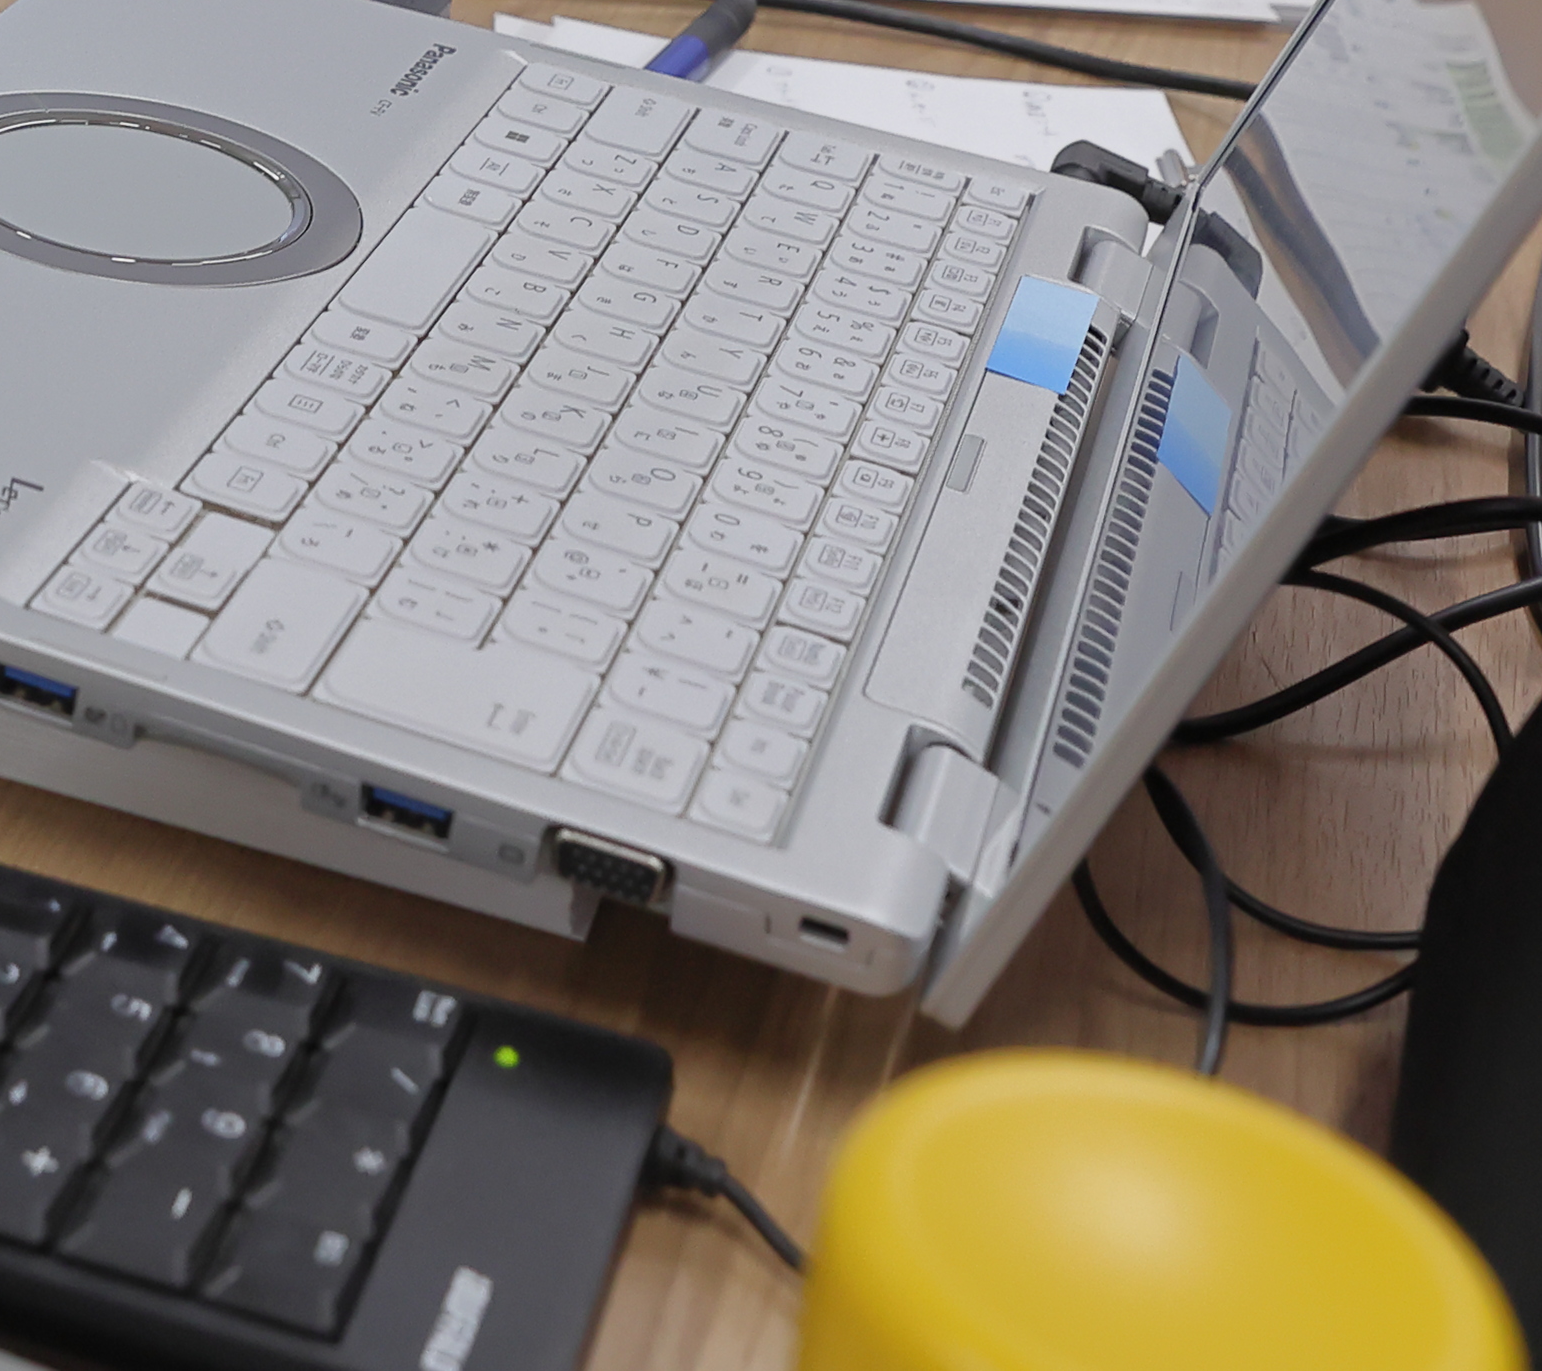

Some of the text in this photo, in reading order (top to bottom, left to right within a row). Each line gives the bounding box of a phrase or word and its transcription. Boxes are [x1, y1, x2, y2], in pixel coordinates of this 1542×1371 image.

[390, 43, 456, 96] Panasonic
[614, 154, 637, 165] Z
[486, 161, 501, 171] Alt
[714, 162, 737, 173] A
[592, 183, 616, 196] X
[810, 180, 835, 190] Q
[884, 183, 905, 191] 1
[696, 194, 719, 204] S
[915, 190, 936, 198] !
[760, 216, 777, 224] て
[794, 211, 818, 225] W
[867, 210, 890, 221] 2
[570, 216, 593, 227] C
[677, 224, 700, 236] D
[776, 242, 800, 253] E
[851, 242, 874, 253] 3
[975, 246, 991, 255] F2
[548, 250, 571, 261] V
[886, 252, 905, 261] #
[657, 258, 679, 269] F
[758, 275, 783, 286] R
[835, 276, 857, 287] 4
[963, 273, 979, 283] F3
[484, 287, 501, 296] こ
[523, 282, 547, 293] B
[868, 285, 891, 295] $
[633, 292, 657, 303] G
[952, 304, 967, 313] F4
[739, 312, 763, 322] T
[817, 310, 841, 322] 5
[496, 317, 522, 331] N
[812, 324, 830, 333] え
[850, 320, 874, 332] %
[571, 334, 587, 342] く
[609, 326, 635, 340] H
[936, 337, 953, 347] F5
[718, 347, 744, 359] Y
[798, 347, 822, 359] 6
[468, 355, 496, 371] M
[833, 357, 856, 368] &
[586, 365, 610, 377] J
[696, 385, 723, 398] U
[779, 385, 804, 398] 7
[446, 399, 460, 408] <
[910, 403, 925, 414] F7
[560, 405, 586, 419] K
[674, 426, 699, 436] I
[758, 425, 784, 438] 8
[266, 433, 286, 448] Ctrl
[419, 439, 433, 449] >
[792, 438, 819, 448] (
[533, 448, 559, 458] L
[349, 472, 369, 486] /
[650, 467, 676, 482] O
[737, 467, 763, 480] 9
[773, 479, 799, 490] )
[382, 485, 406, 496] ?
[512, 495, 528, 504] +
[628, 513, 652, 527] P
[714, 513, 741, 526] 0
[860, 514, 880, 530] F10
[844, 554, 863, 571] F11
[736, 573, 749, 585] =
[825, 597, 845, 614] F12
[110, 993, 152, 1021] 5
[243, 1029, 286, 1058] 8
[66, 1070, 108, 1102] 6
[201, 1108, 246, 1139] 9
